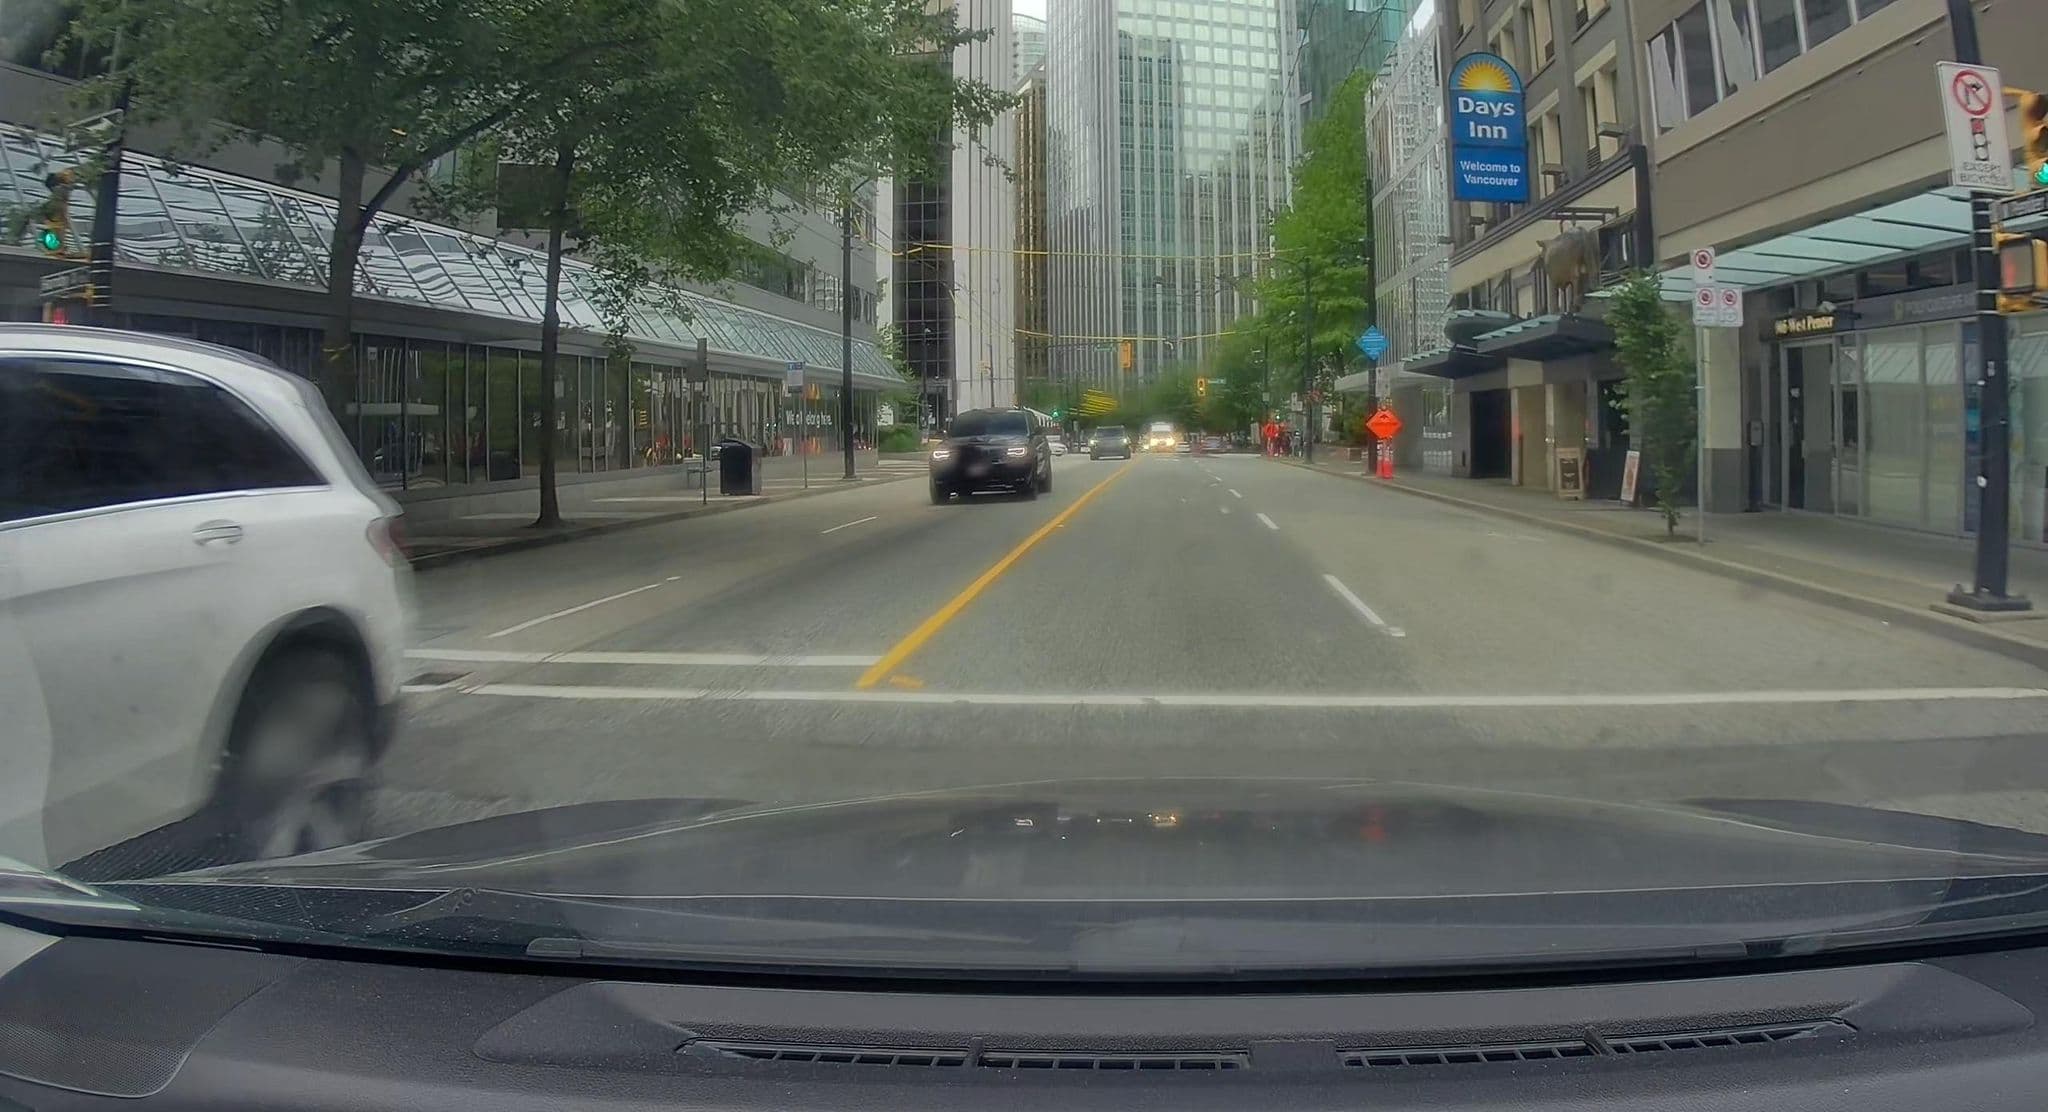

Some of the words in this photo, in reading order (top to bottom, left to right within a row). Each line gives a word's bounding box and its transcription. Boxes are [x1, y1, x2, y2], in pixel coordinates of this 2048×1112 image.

[1458, 97, 1515, 118] Days
[1469, 121, 1508, 139] Inn
[1460, 161, 1508, 173] Welcome
[1510, 163, 1520, 173] to
[1463, 174, 1519, 186] Vancouver
